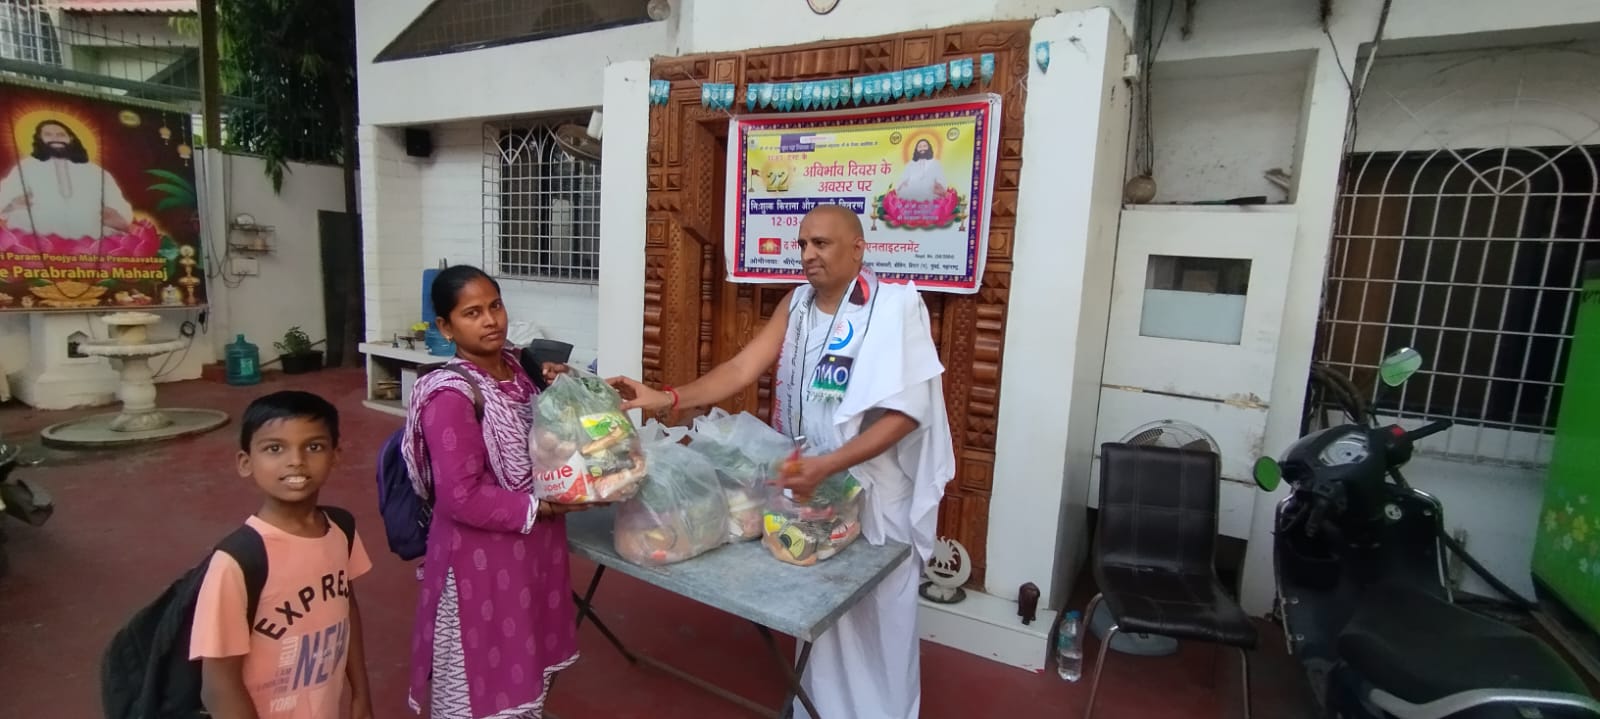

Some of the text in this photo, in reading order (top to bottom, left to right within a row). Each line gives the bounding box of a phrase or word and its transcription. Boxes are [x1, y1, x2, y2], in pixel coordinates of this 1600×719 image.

[803, 158, 892, 177] अविर्भाव दिवस के
[818, 179, 873, 193] अवसर पर
[7, 252, 41, 262] Param
[43, 253, 77, 264] Poojya
[13, 266, 109, 279] Parabrahma
[112, 267, 168, 282] Maharaj
[292, 618, 350, 691] NEW
